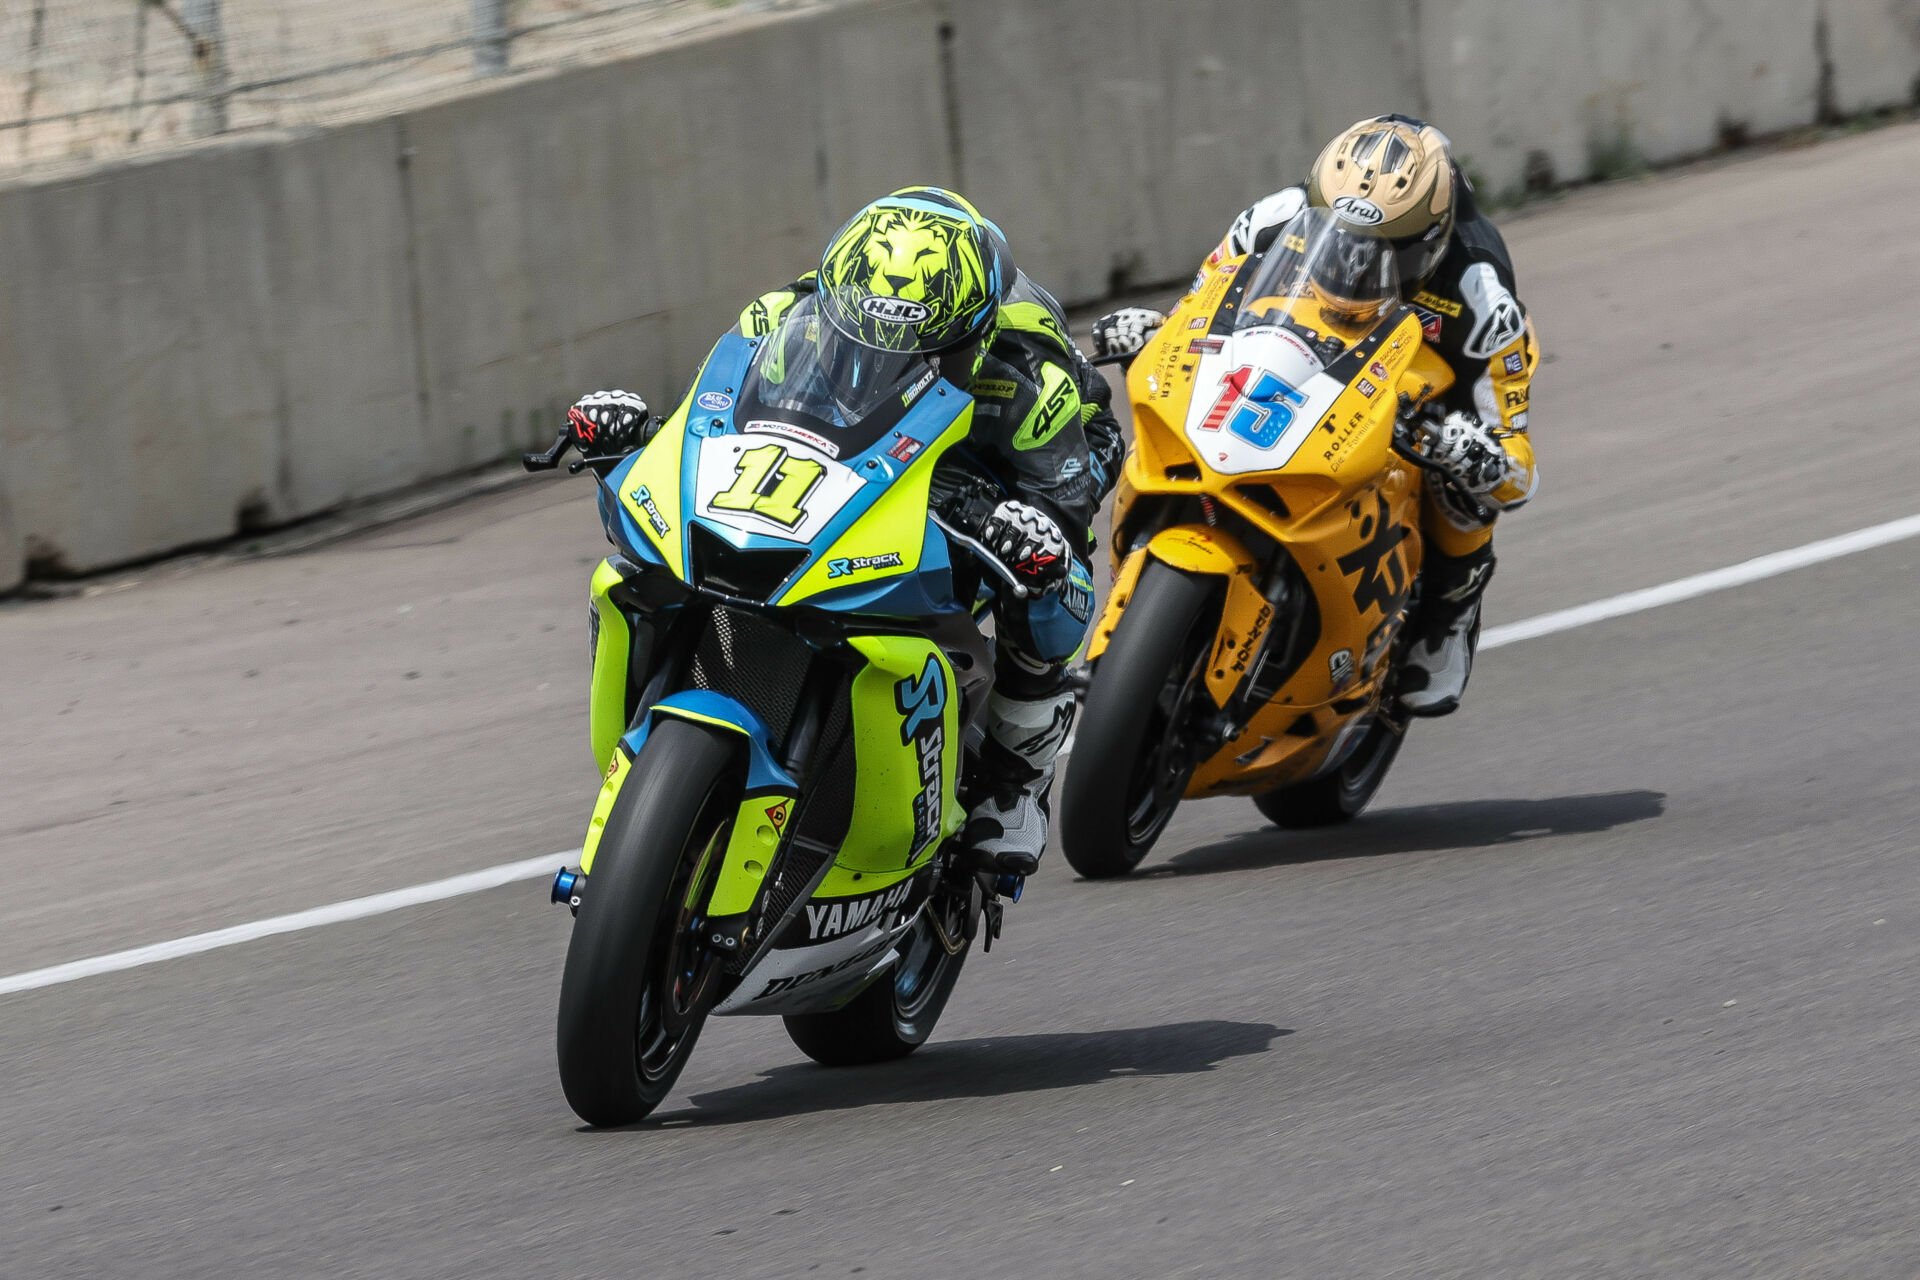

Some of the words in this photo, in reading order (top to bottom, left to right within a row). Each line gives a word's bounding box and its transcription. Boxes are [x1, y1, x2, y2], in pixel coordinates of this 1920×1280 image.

[1337, 199, 1380, 220] Arai
[867, 300, 923, 319] HJC
[1161, 345, 1181, 398] ROLLER
[1198, 364, 1310, 451] 15
[761, 424, 828, 447] MOTOAMERICA
[1323, 411, 1365, 461] ROLLER
[707, 444, 827, 534] 11
[1231, 604, 1271, 672] DUNLOP
[806, 877, 915, 940] YAMAHA
